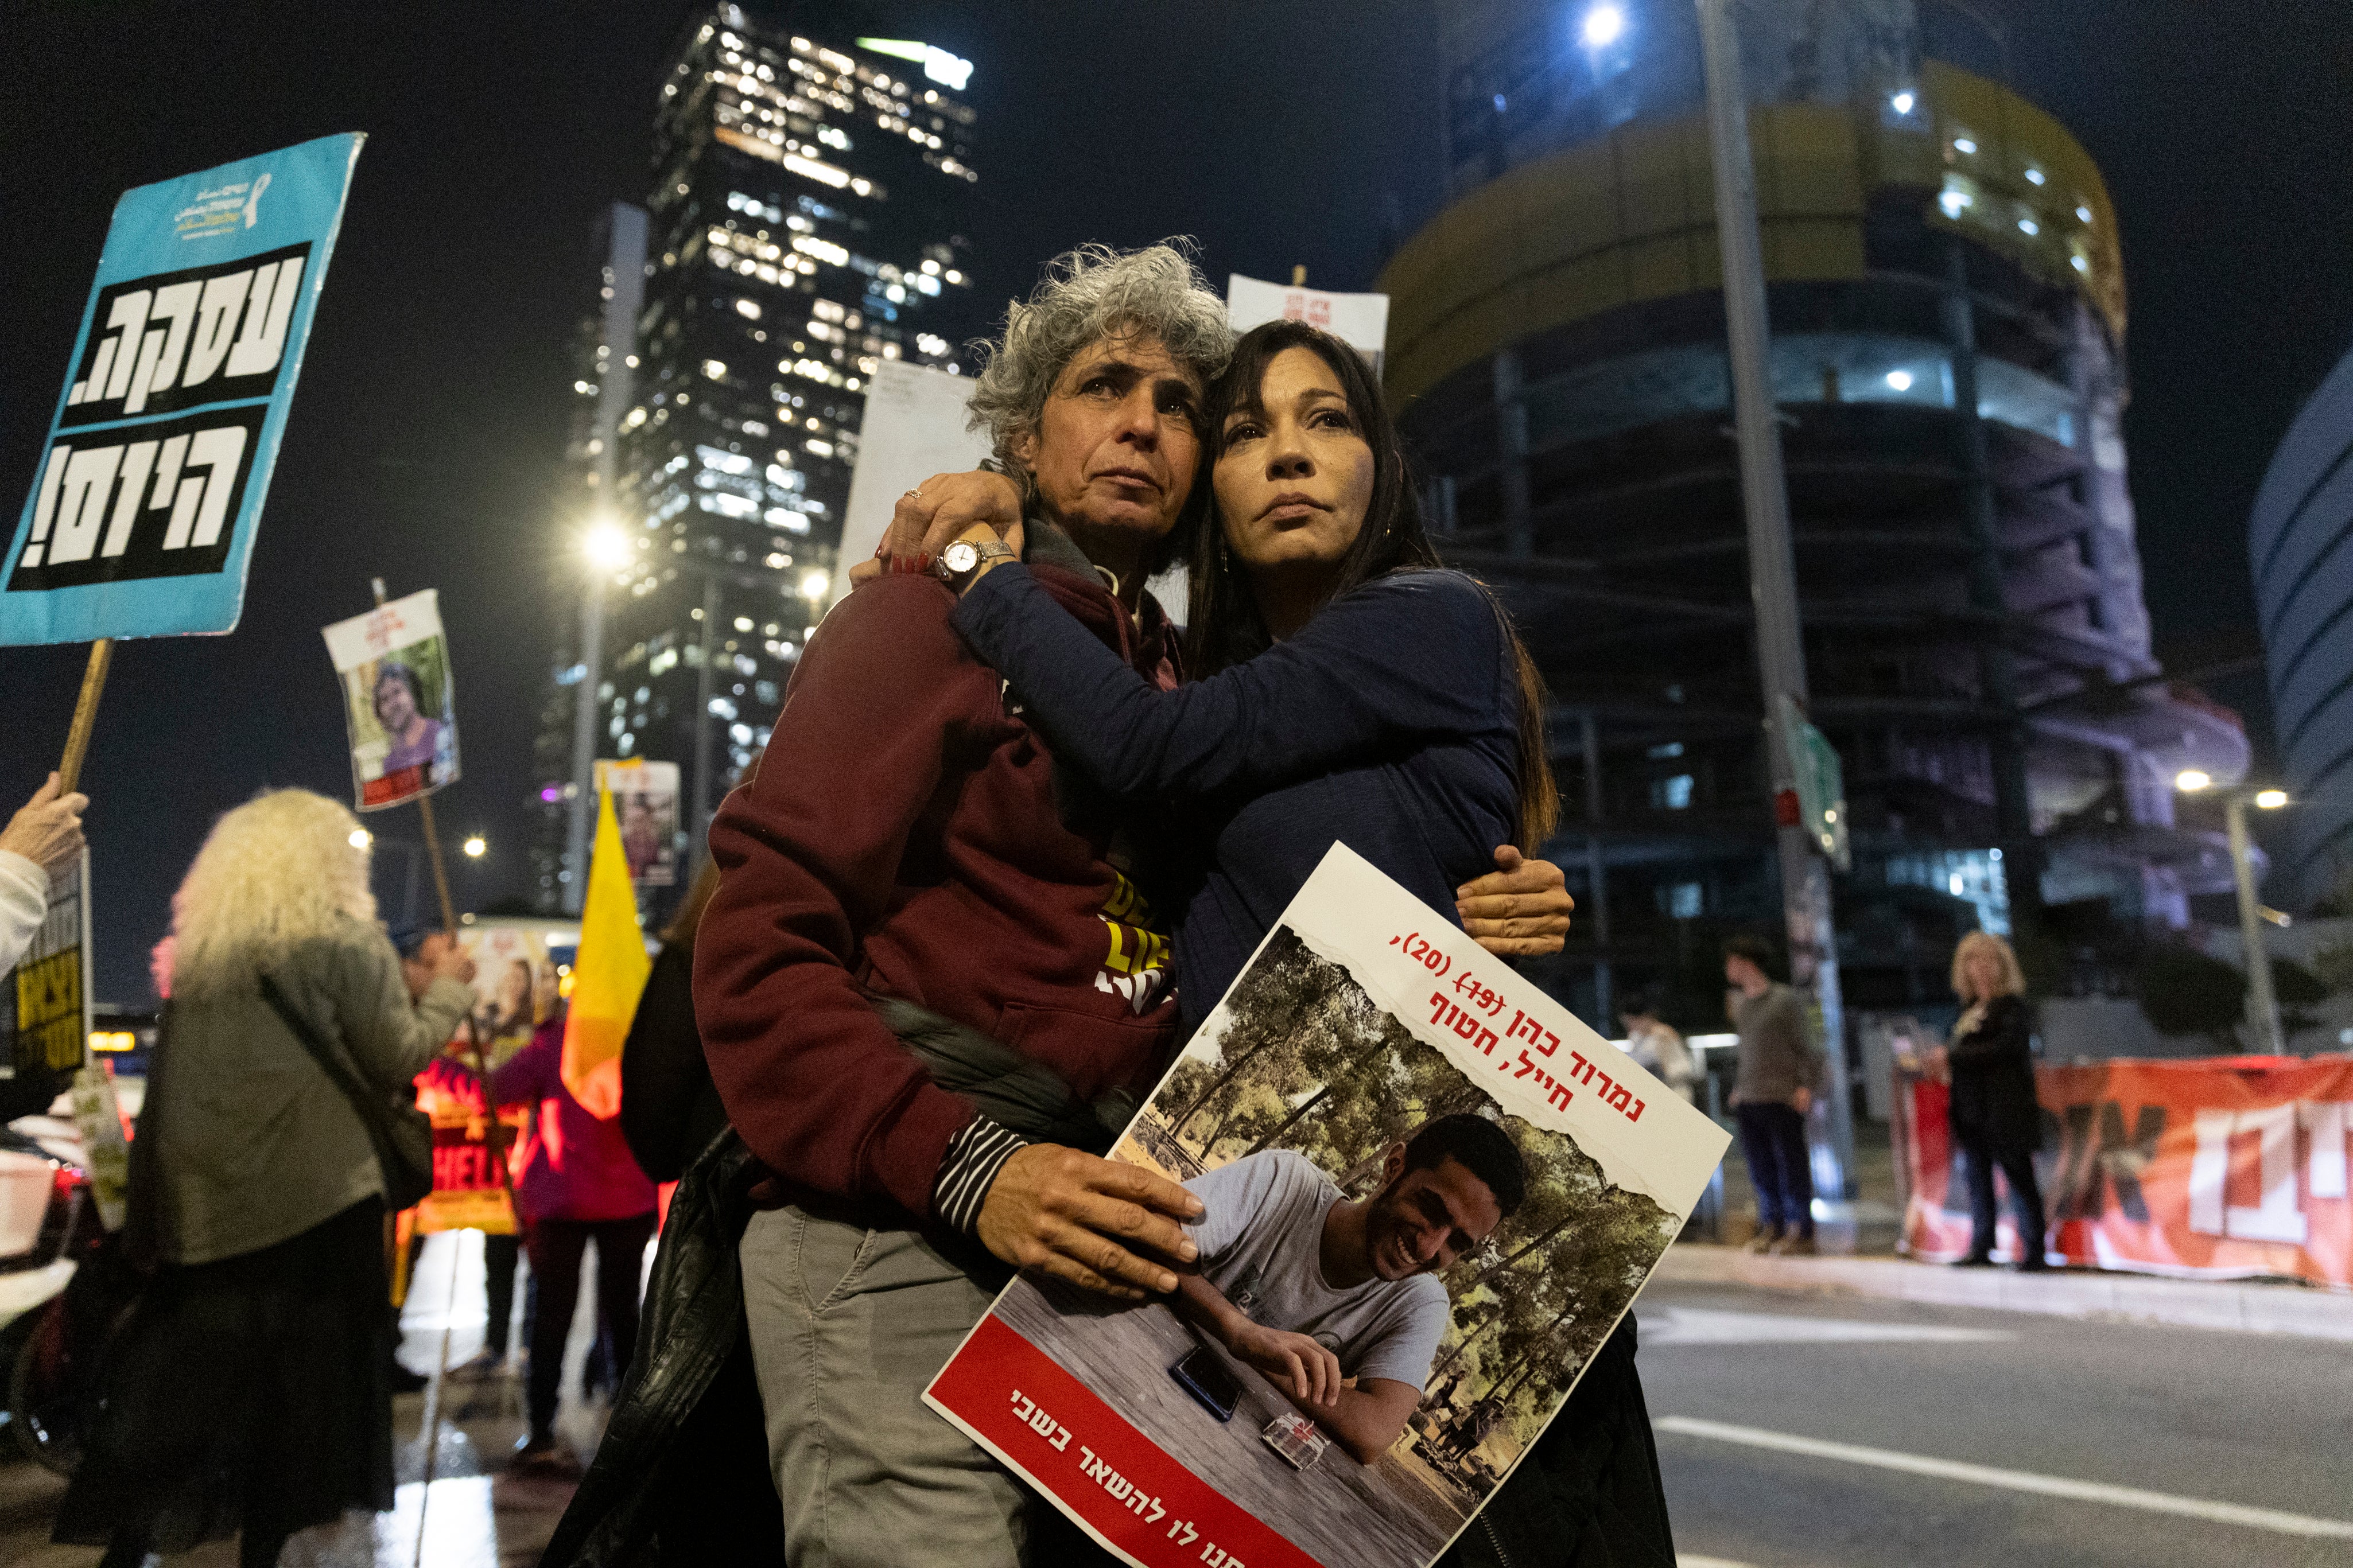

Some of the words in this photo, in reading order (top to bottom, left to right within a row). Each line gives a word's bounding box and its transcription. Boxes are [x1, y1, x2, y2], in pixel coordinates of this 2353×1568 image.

[67, 256, 305, 414] עסקה.
[20, 426, 248, 567] היום!
[1389, 932, 1451, 977] (20),
[1430, 991, 1499, 1056] חטוף
[1505, 1009, 1561, 1057] כהן
[1498, 1049, 1574, 1112] חייל,
[1571, 1050, 1645, 1122] נמרוד
[1010, 1389, 1072, 1452] בשבי
[1079, 1445, 1166, 1524] להשאר
[1167, 1519, 1199, 1546] לו
